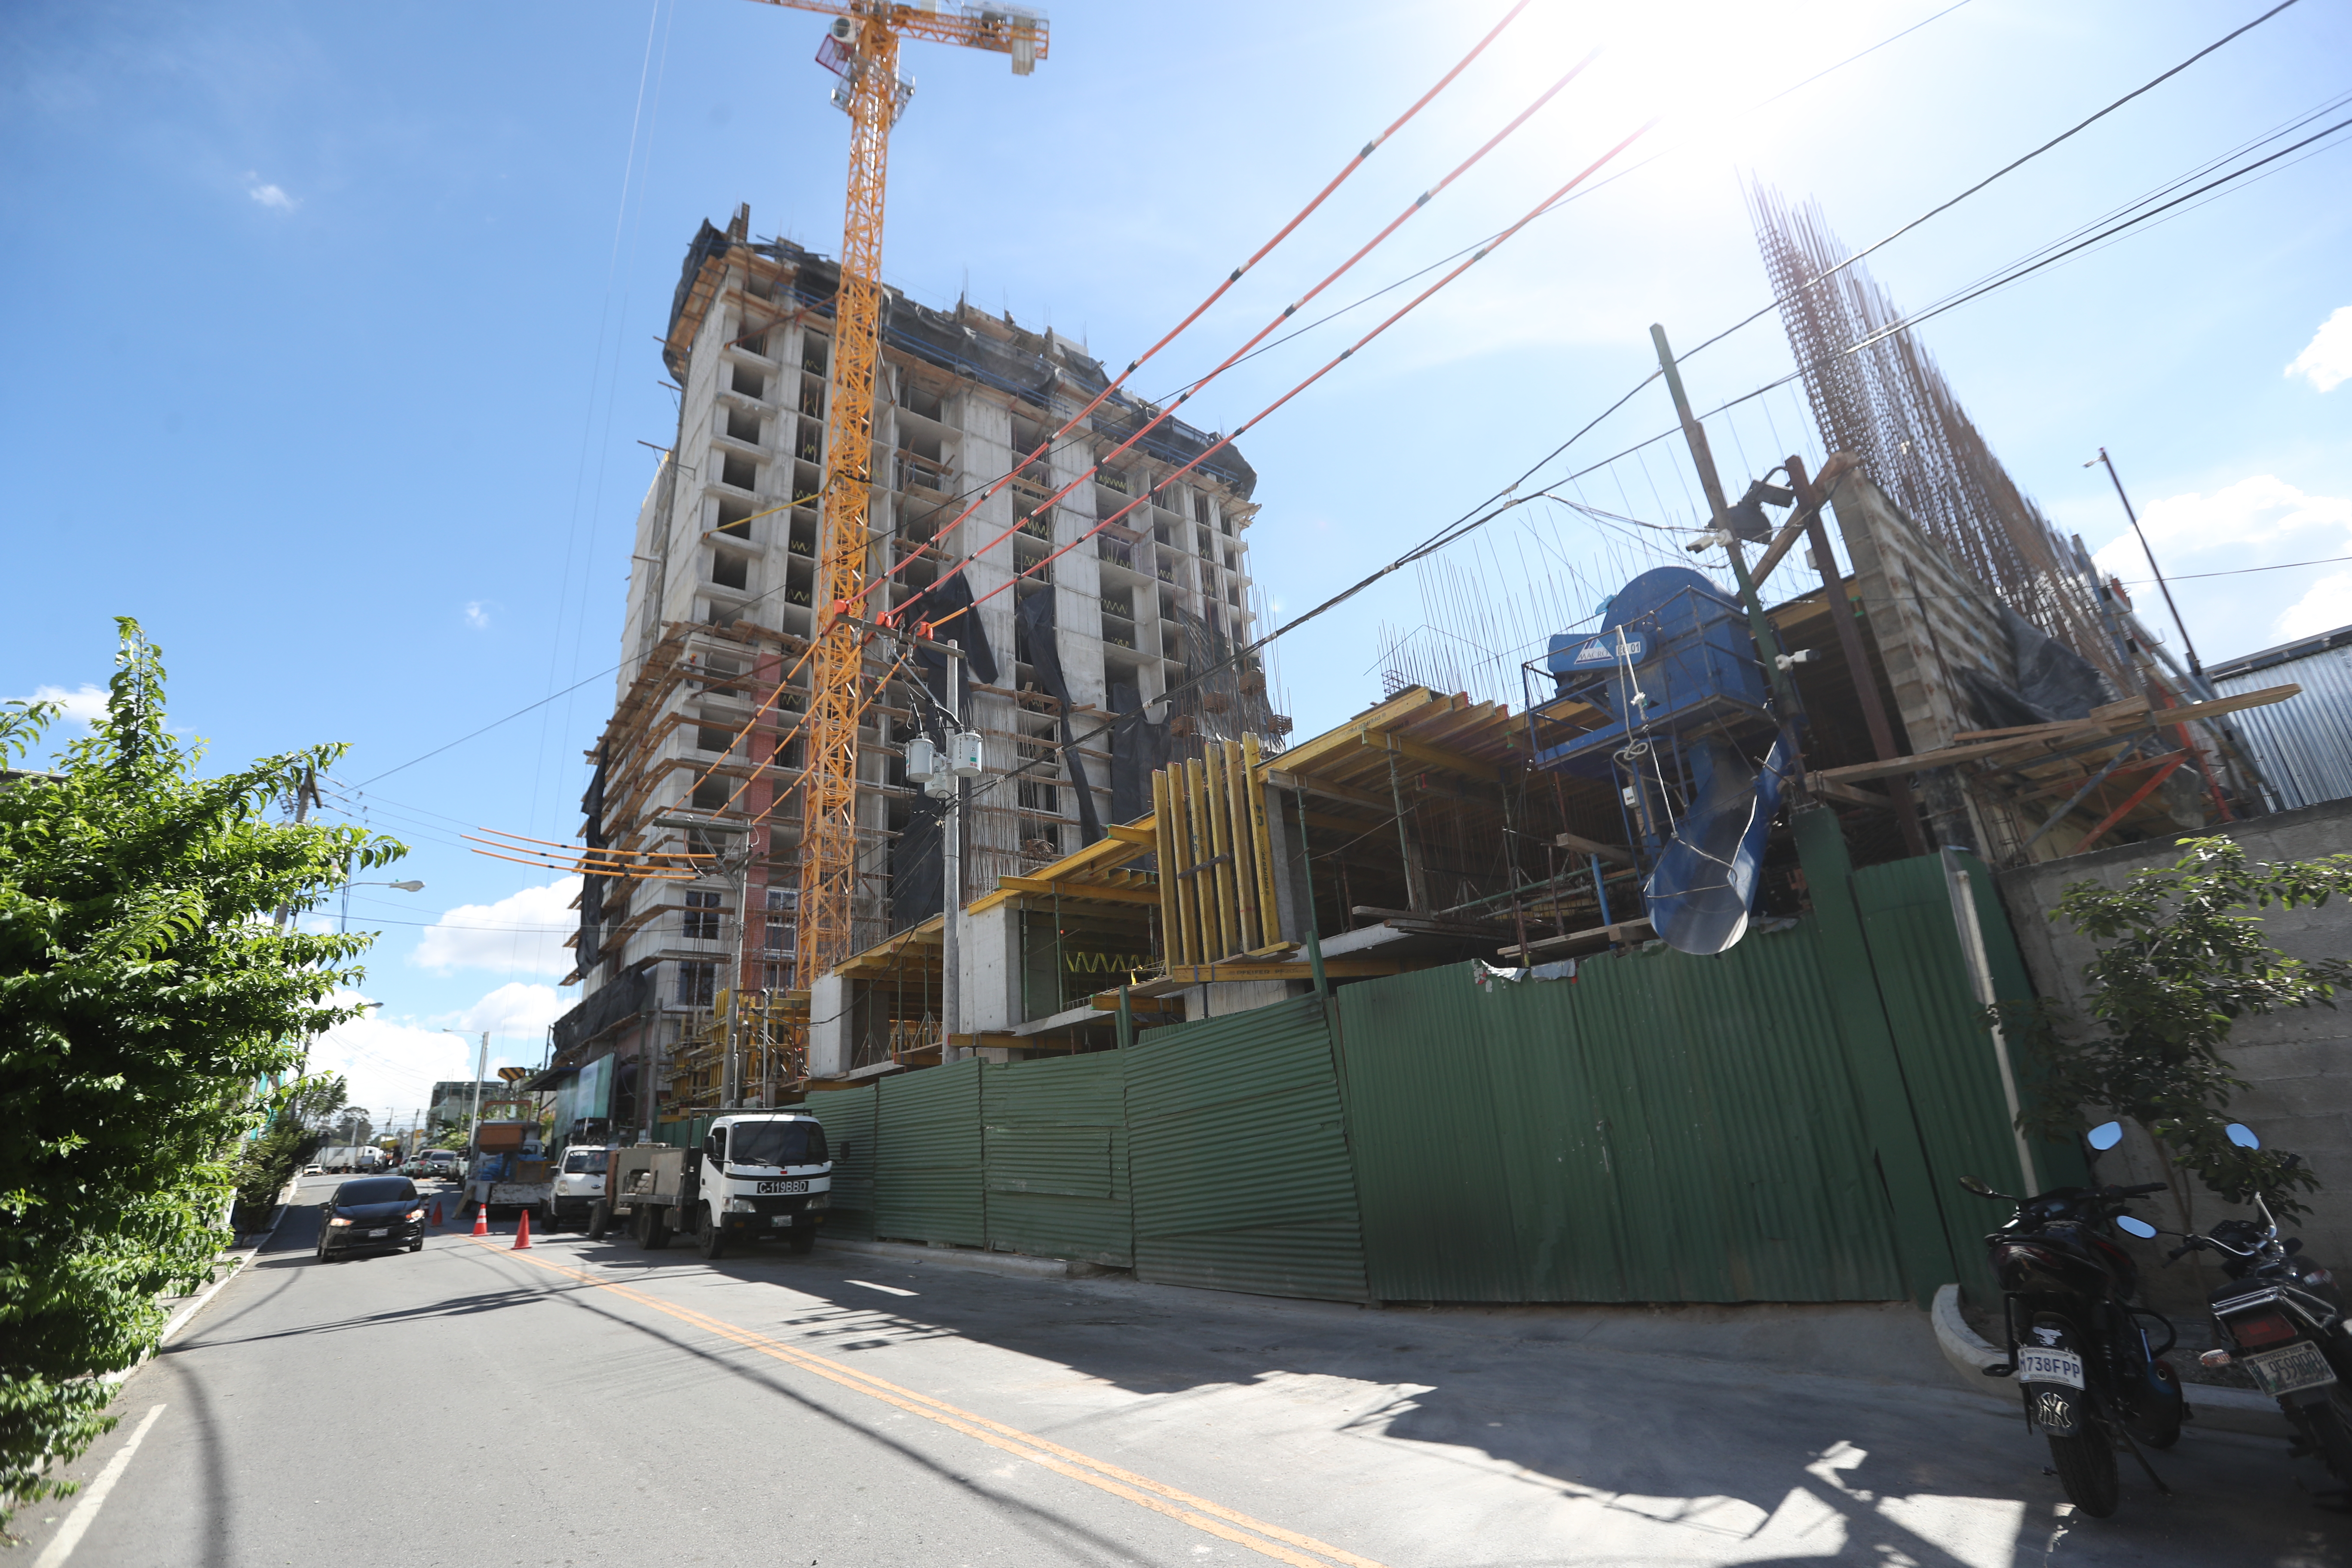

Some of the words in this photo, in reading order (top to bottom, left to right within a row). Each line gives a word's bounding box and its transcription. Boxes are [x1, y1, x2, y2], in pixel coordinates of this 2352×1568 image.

[1631, 643, 1640, 652] 01
[1578, 649, 1608, 660] MACRO
[759, 1181, 806, 1194] C-119BBD
[2020, 1357, 2080, 1378] M738FPP
